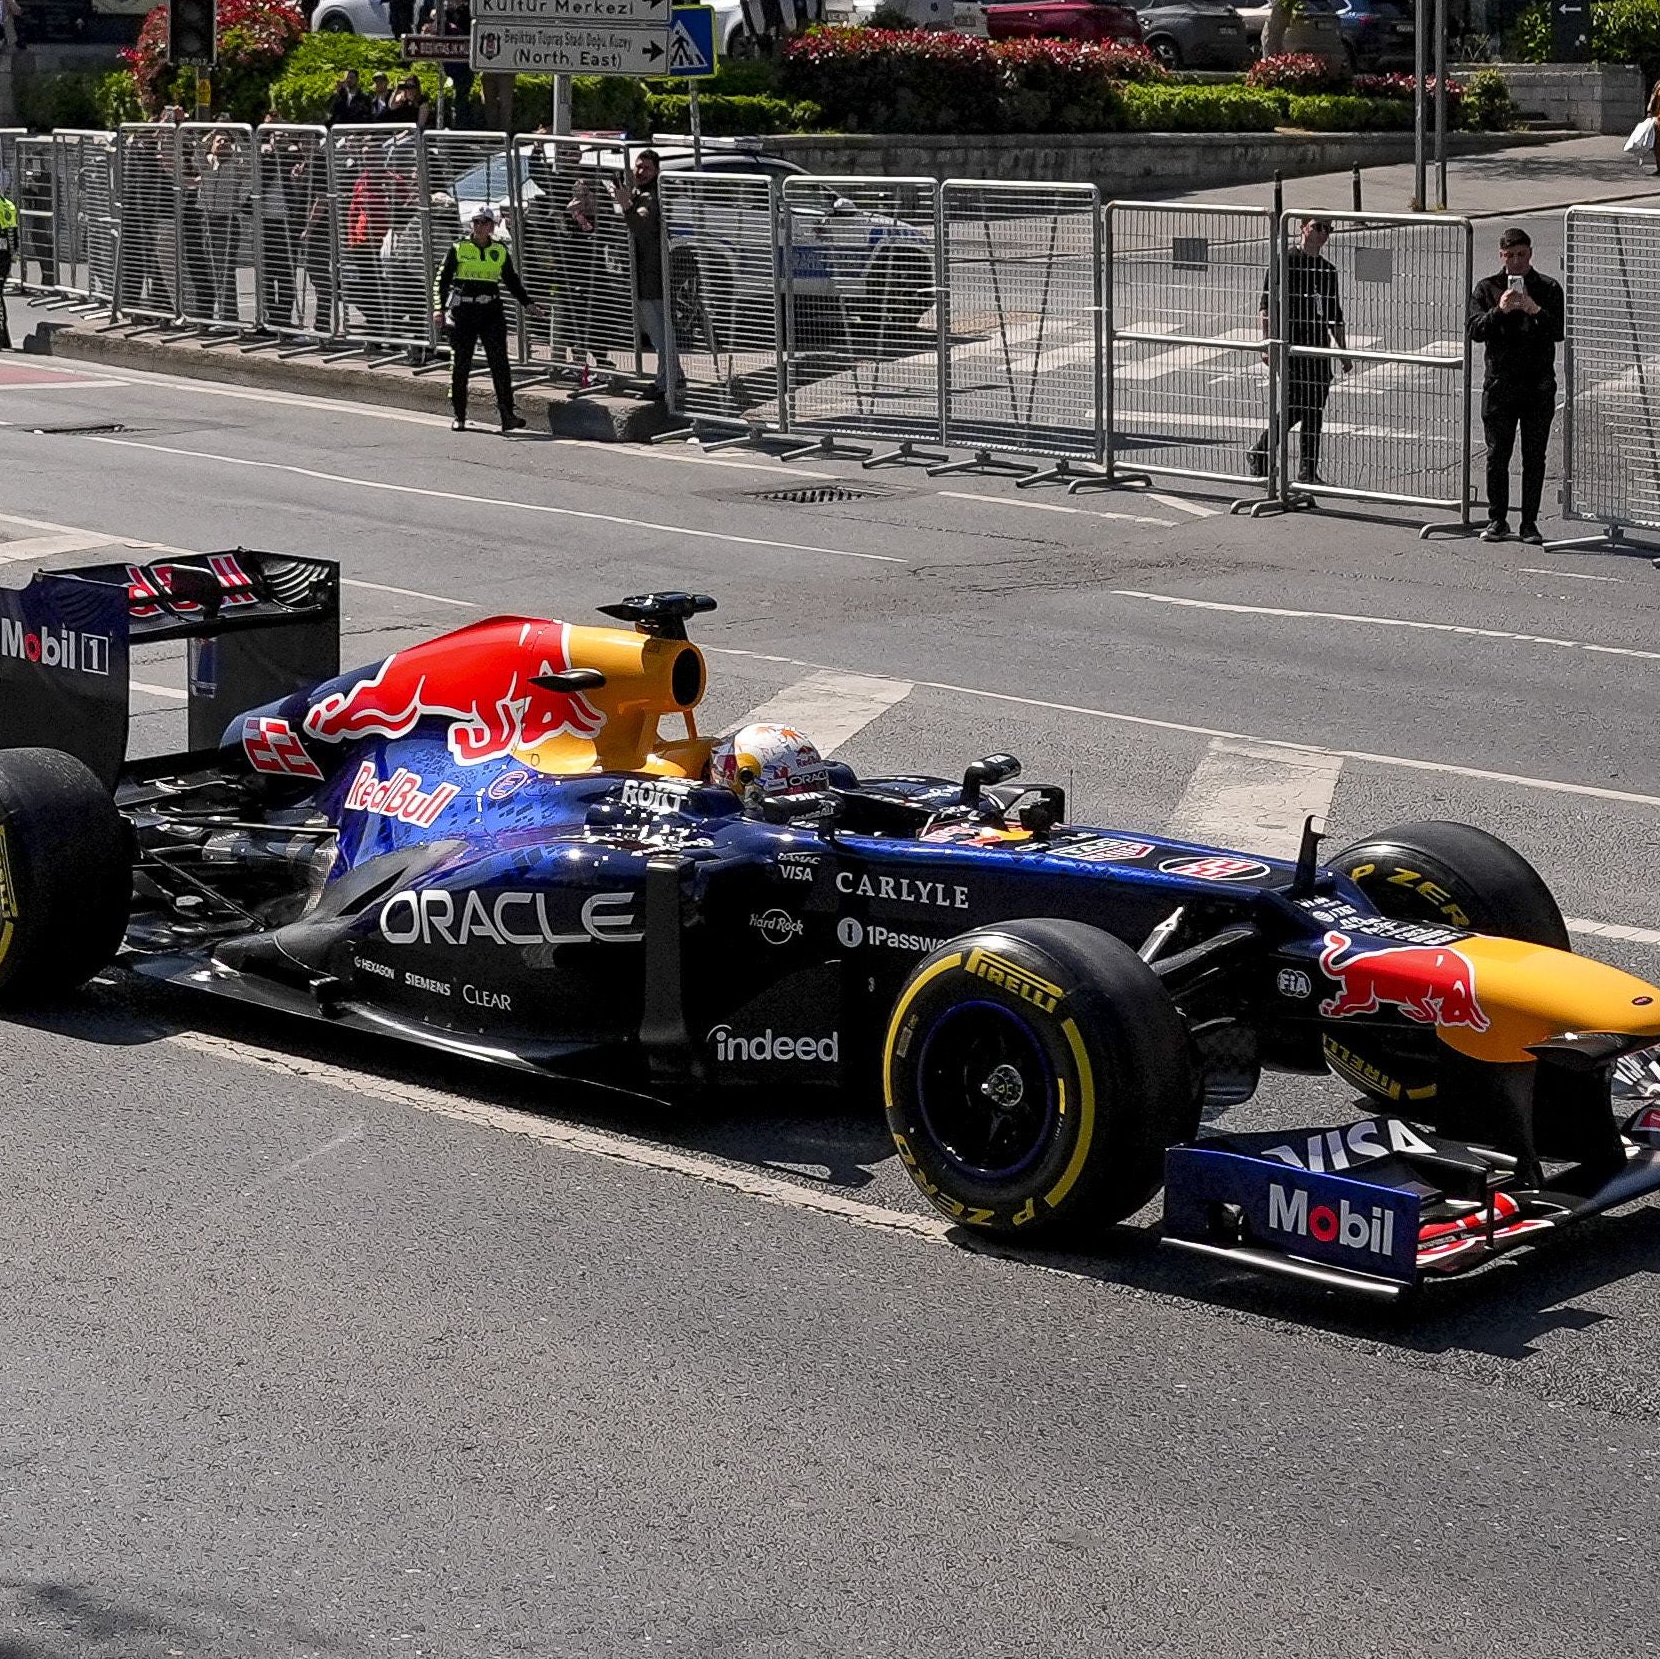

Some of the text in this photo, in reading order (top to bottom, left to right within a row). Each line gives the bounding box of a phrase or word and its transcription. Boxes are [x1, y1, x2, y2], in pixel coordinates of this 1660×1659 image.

[514, 48, 621, 70] (North, East)
[1, 617, 75, 670] Mobil
[778, 864, 814, 882] VISA
[835, 871, 970, 910] CARLYLE
[1386, 867, 1471, 928] ZER
[379, 889, 646, 945] ORACLE
[749, 912, 804, 936] Hard Rock
[866, 925, 945, 953] 1Passw
[360, 958, 512, 1012] HEXAGON SIEMENS CLEAR
[964, 946, 1067, 1014] PIRELLI
[706, 1024, 839, 1063] indeed
[1260, 1119, 1438, 1173] VISA
[1268, 1183, 1394, 1256] Mobil
